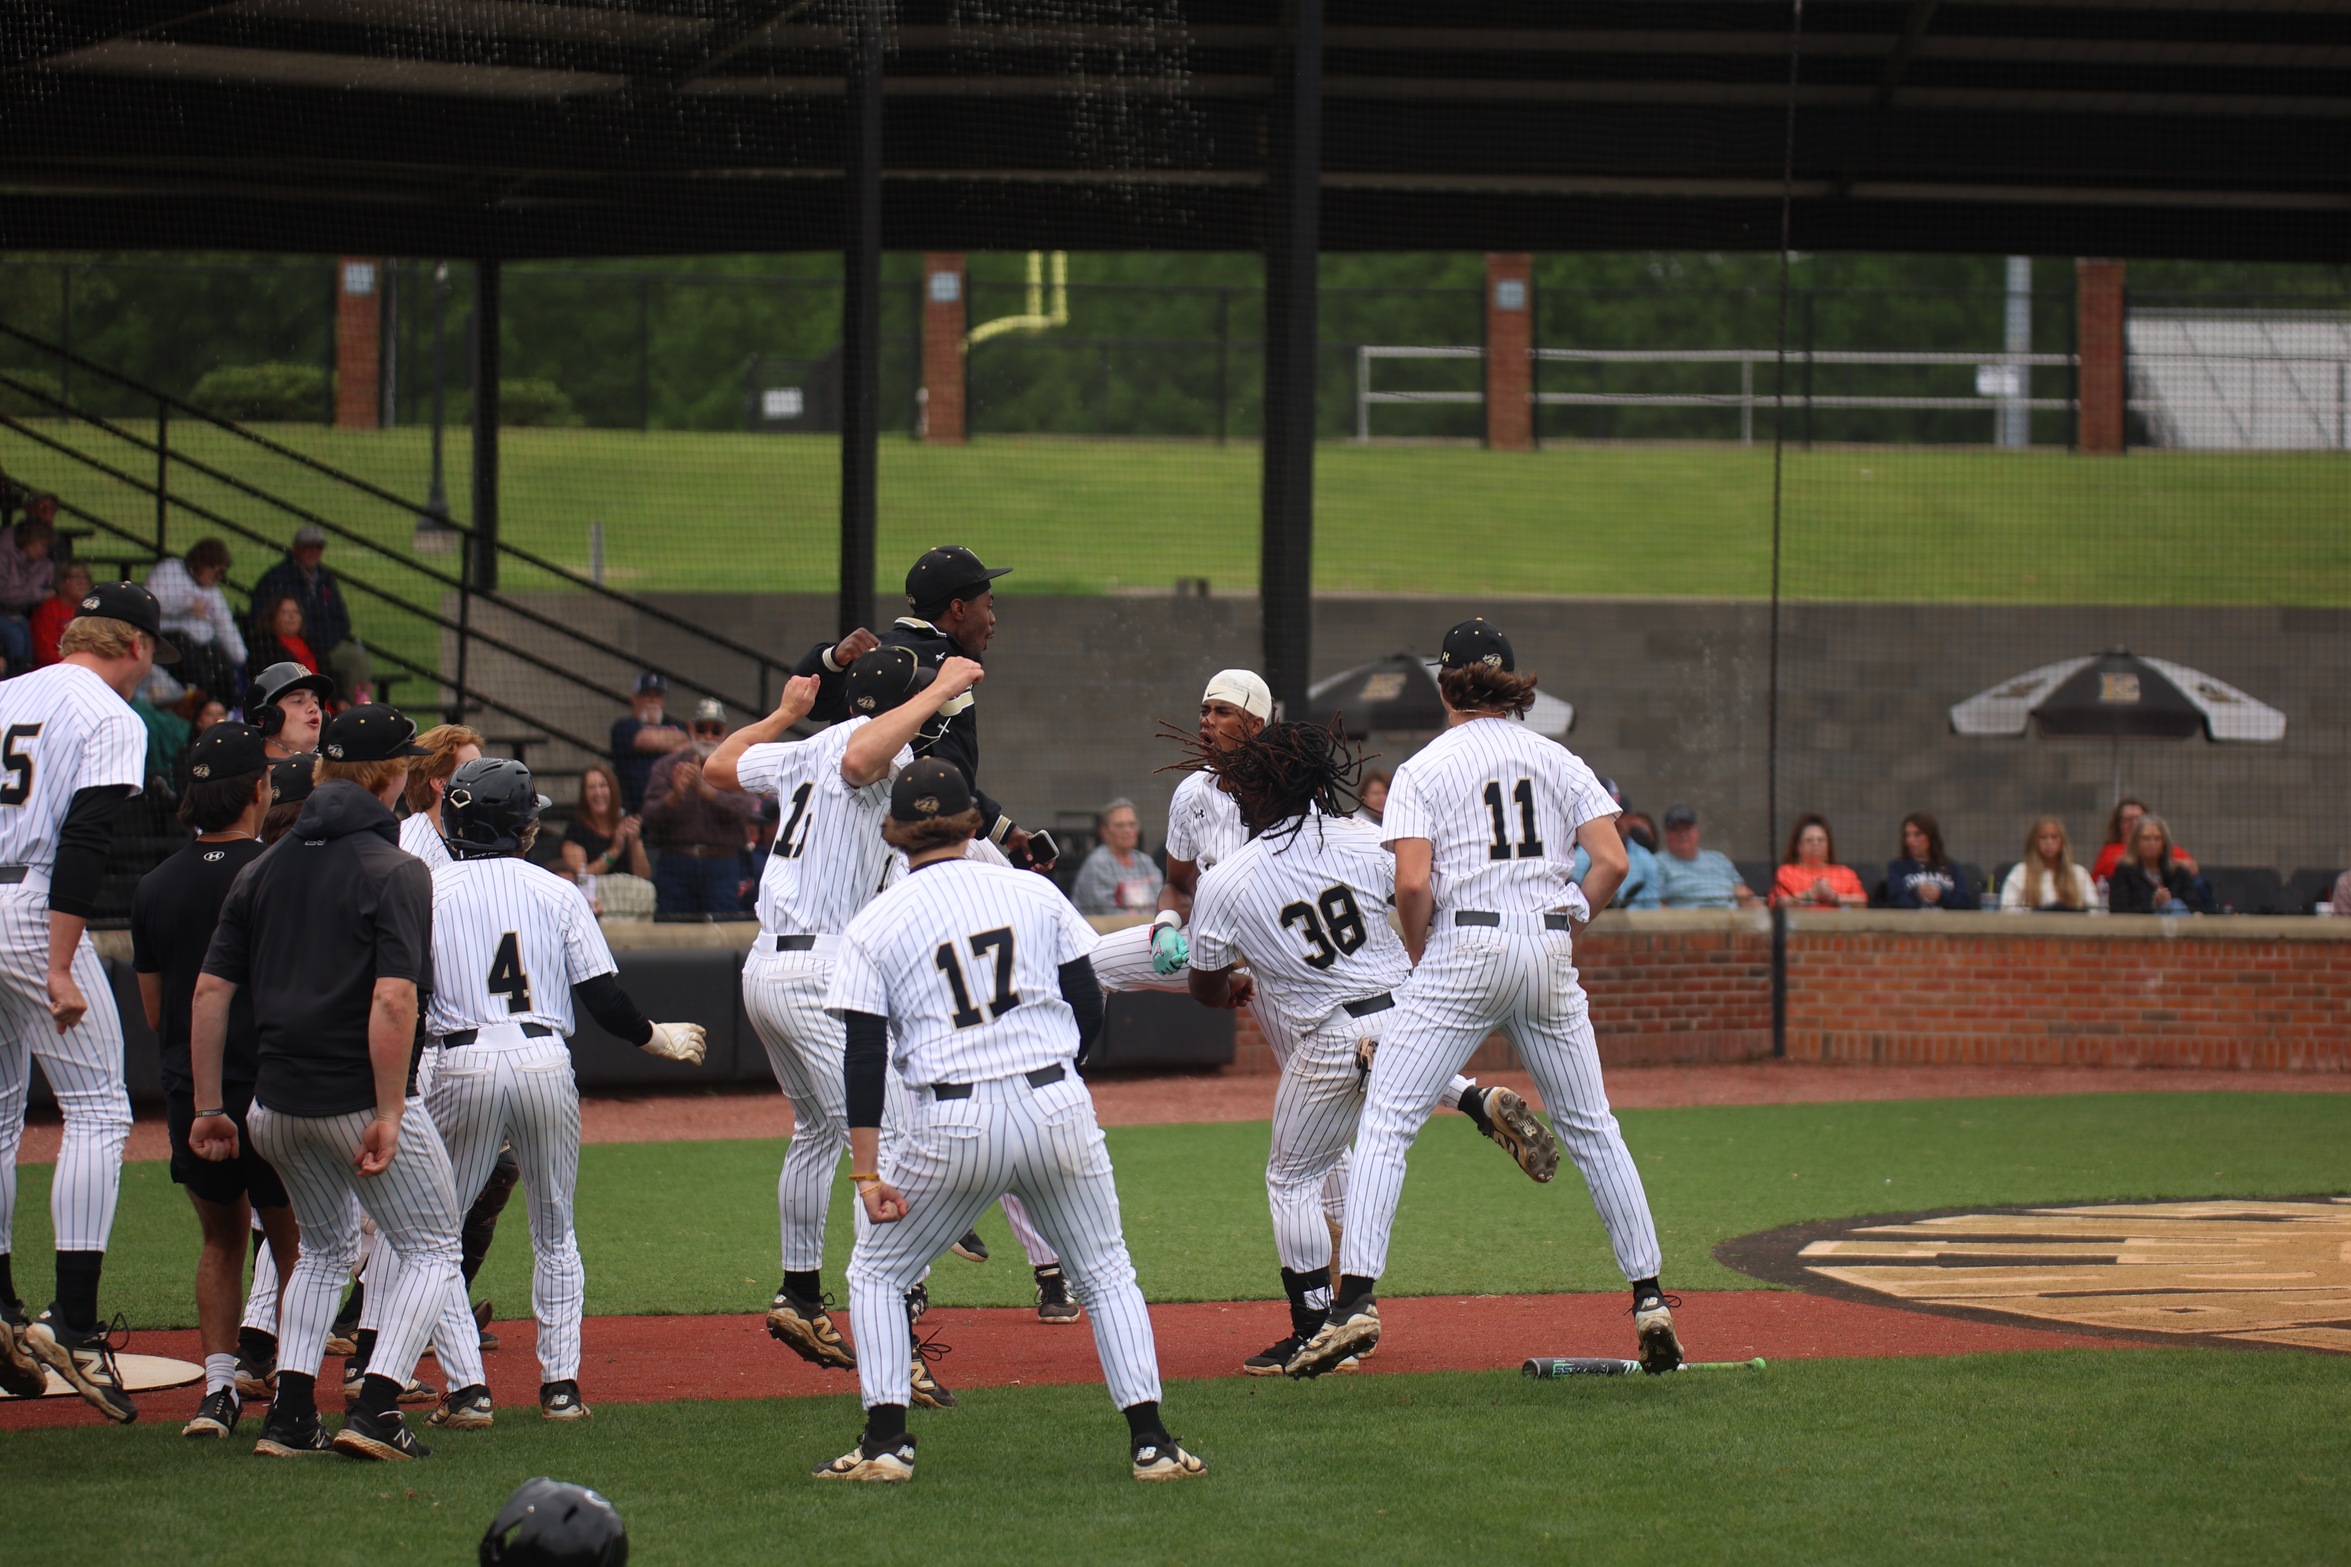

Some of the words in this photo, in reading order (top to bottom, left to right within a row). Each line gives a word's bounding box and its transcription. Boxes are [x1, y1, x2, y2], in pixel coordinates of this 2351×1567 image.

[1481, 776, 1545, 861] 11
[1279, 882, 1368, 970] 38
[487, 931, 534, 1015] 4
[933, 924, 1023, 1031] 17
[549, 1394, 569, 1407] NB
